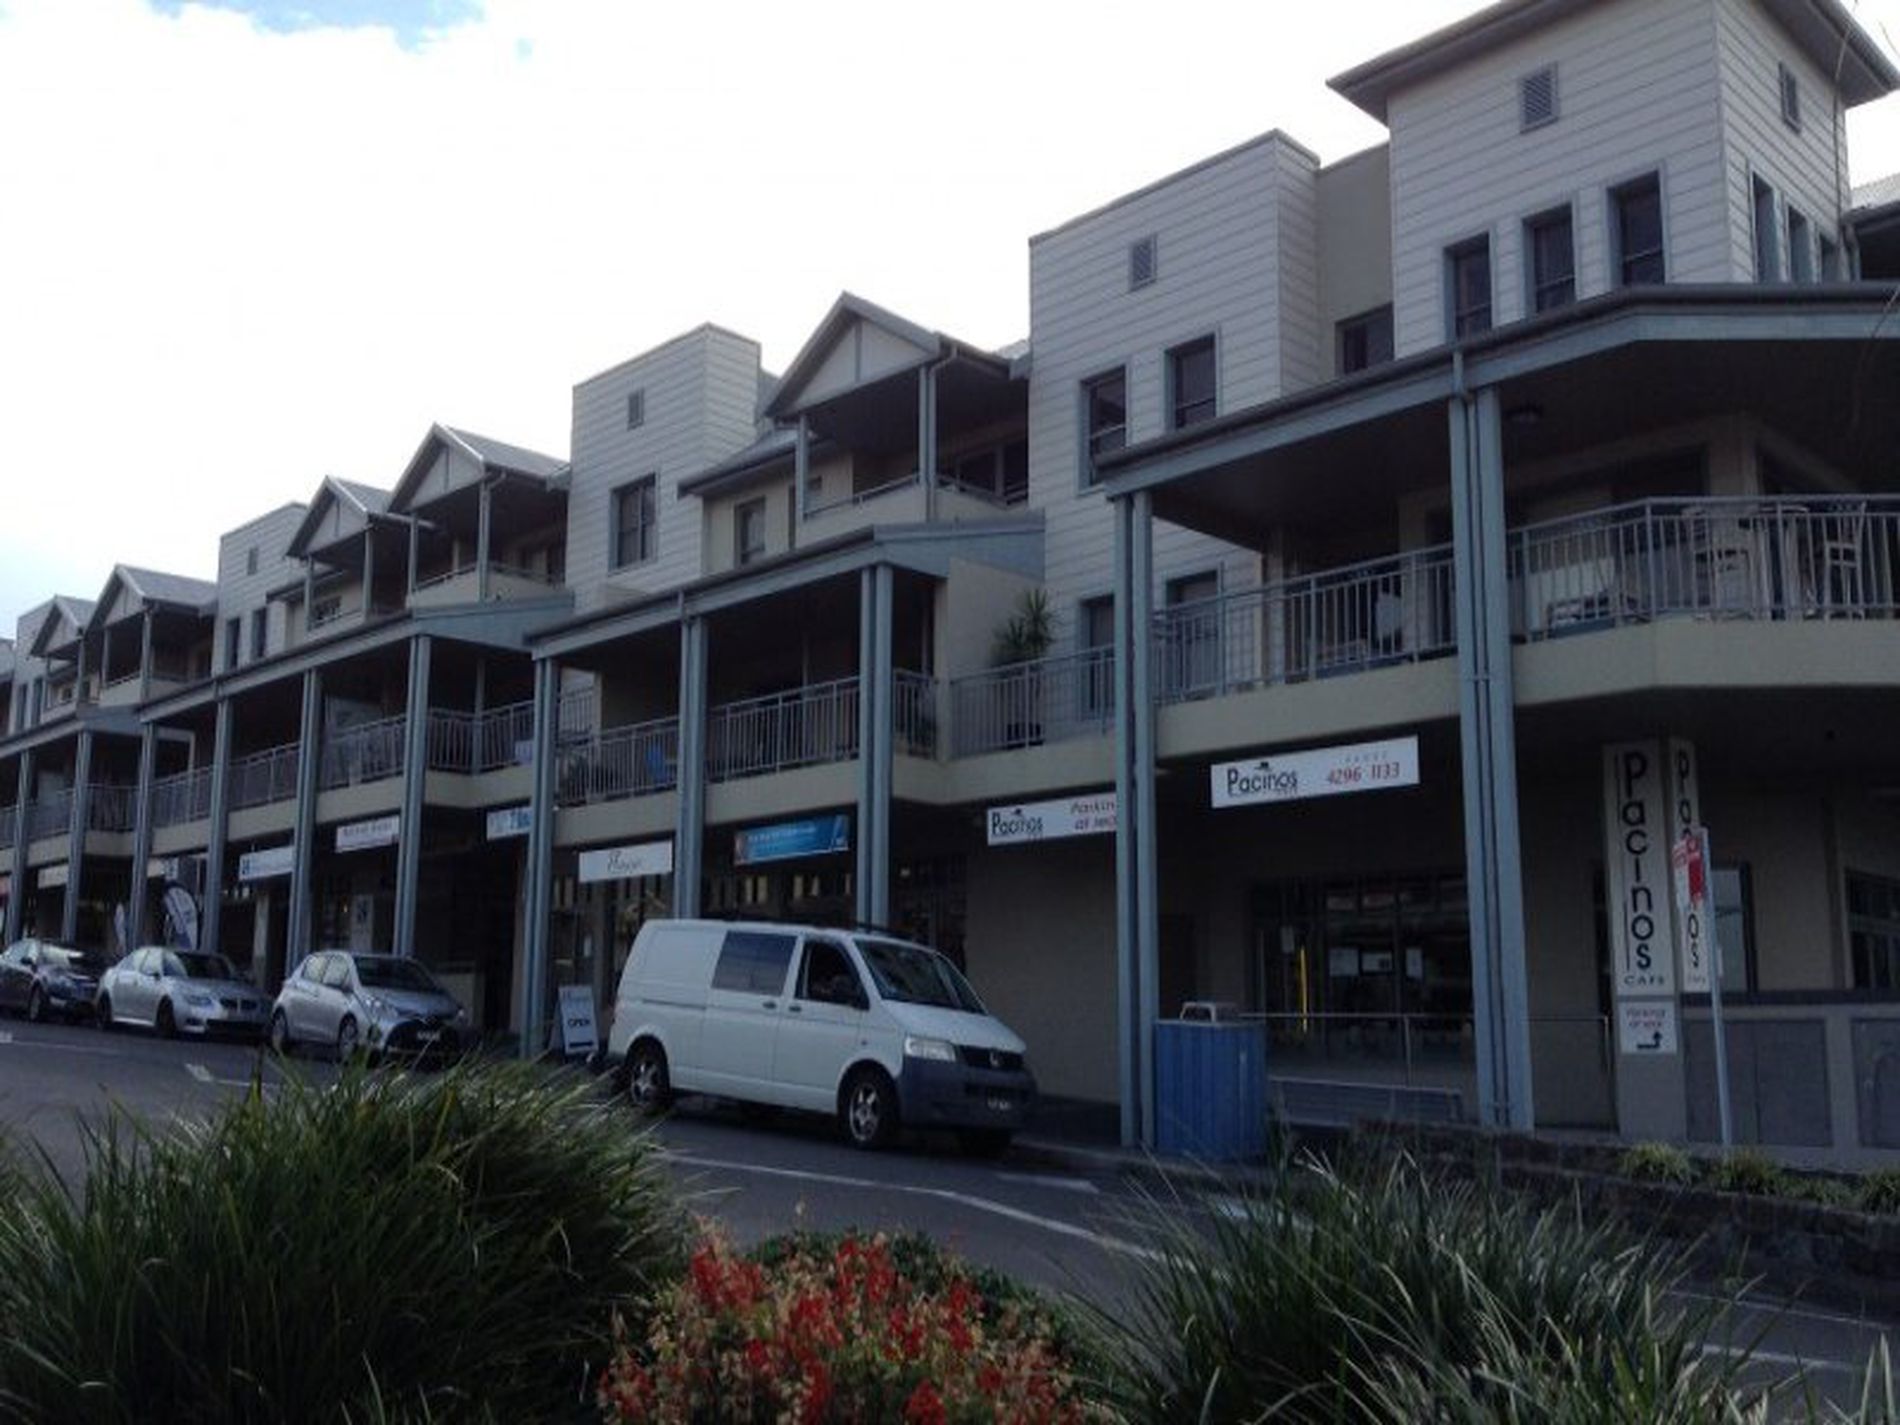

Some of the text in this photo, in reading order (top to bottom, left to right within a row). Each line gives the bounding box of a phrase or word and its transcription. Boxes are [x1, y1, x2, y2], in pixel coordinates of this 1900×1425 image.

[1227, 768, 1298, 797] Pacinos
[1327, 762, 1401, 785] 4296 1133
[1070, 799, 1116, 815] Parkin
[1622, 751, 1655, 970] Pacinos
[1677, 750, 1700, 969] Paos
